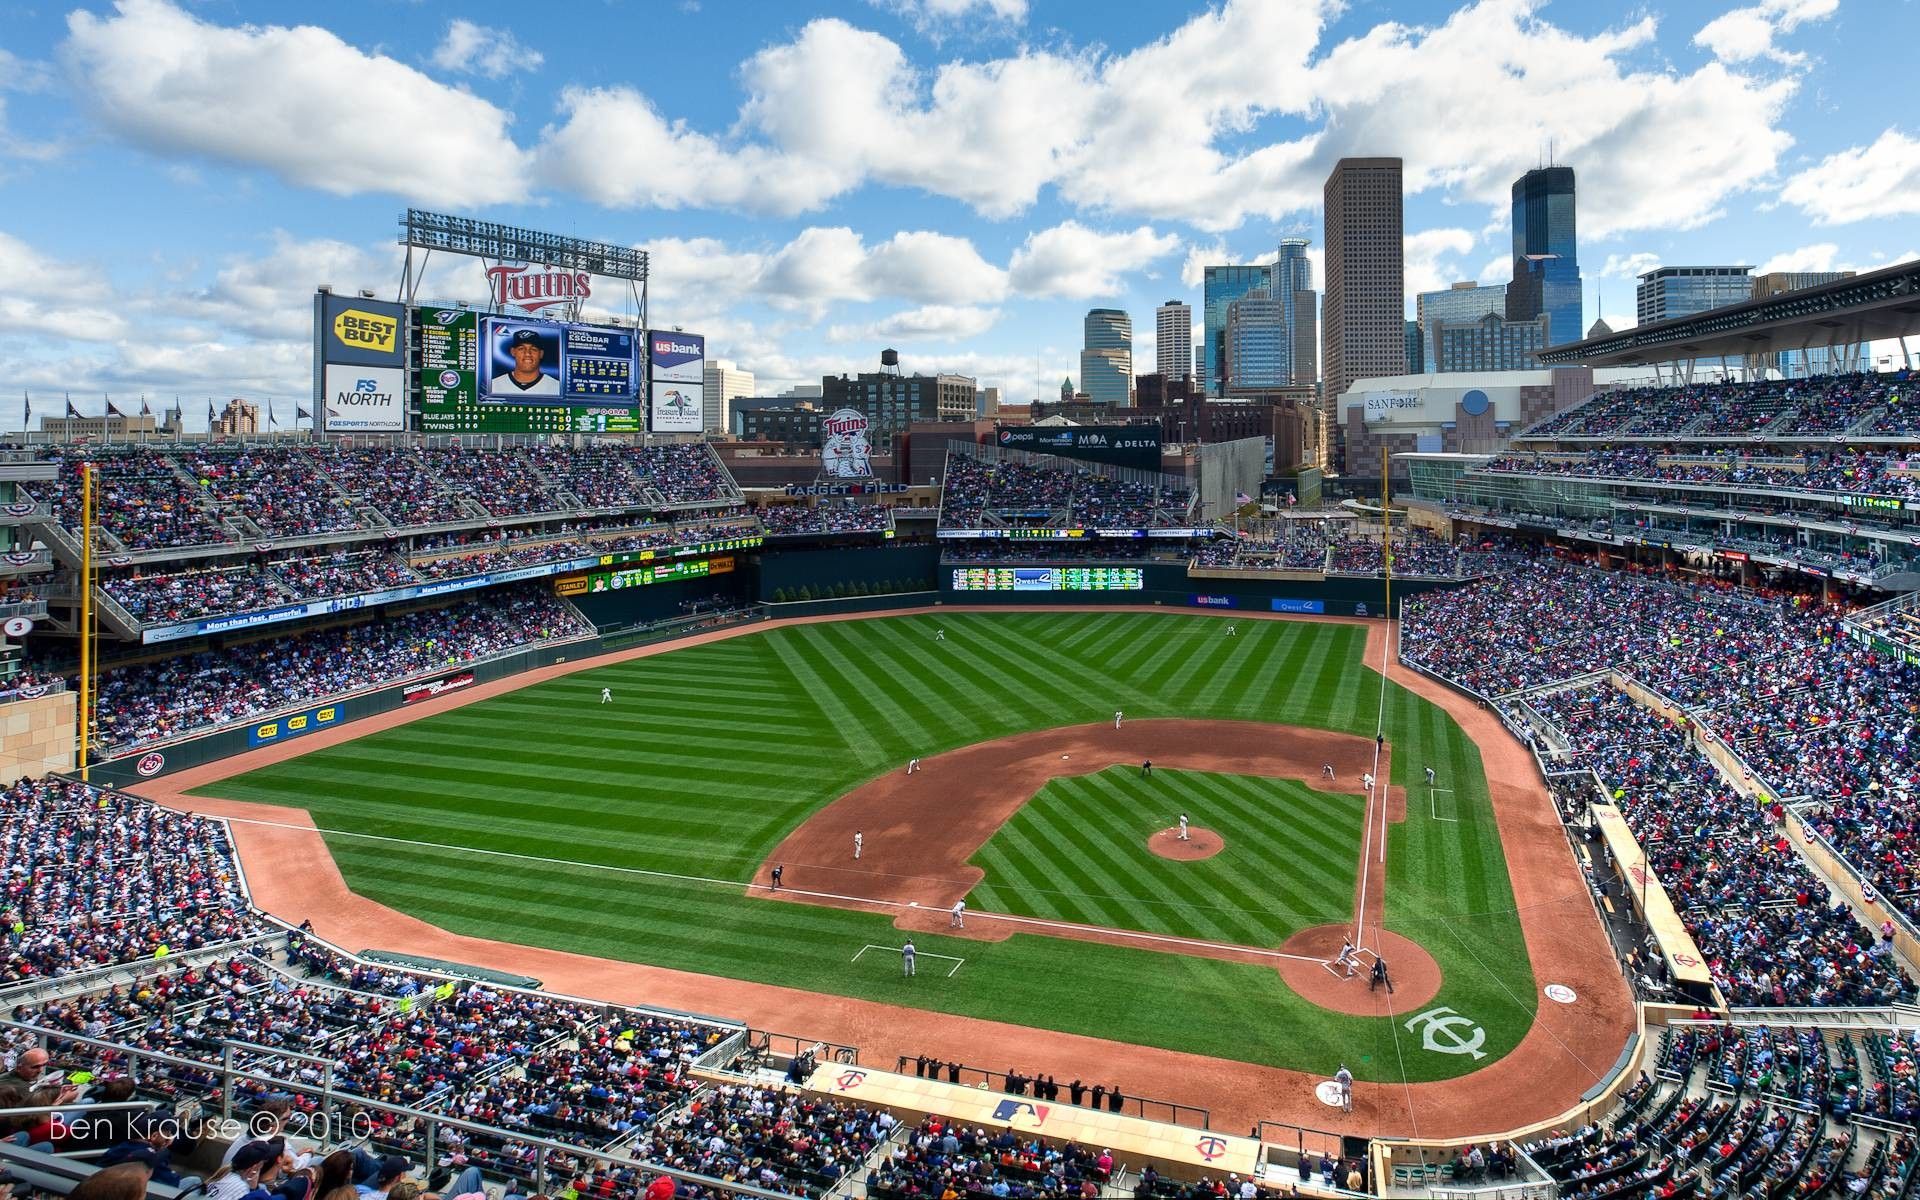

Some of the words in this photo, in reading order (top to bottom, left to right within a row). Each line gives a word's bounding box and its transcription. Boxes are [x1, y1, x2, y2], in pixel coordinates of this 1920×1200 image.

[485, 263, 591, 305] Twins
[344, 316, 394, 334] BEST
[344, 328, 390, 345] BUY
[568, 335, 610, 344] ESCOBAR
[356, 379, 377, 392] FS
[337, 392, 392, 406] NORTH
[656, 407, 678, 416] Treasure
[684, 408, 699, 416] Island
[823, 416, 868, 438] Twins
[1012, 433, 1034, 442] pepsi
[788, 486, 849, 496] TARGET
[865, 484, 909, 494] FIELD
[558, 582, 585, 591] STANLEY
[207, 622, 228, 630] More
[229, 618, 248, 626] than
[268, 609, 302, 621] powerful
[14, 622, 23, 631] 3
[429, 678, 473, 694] Budweiser
